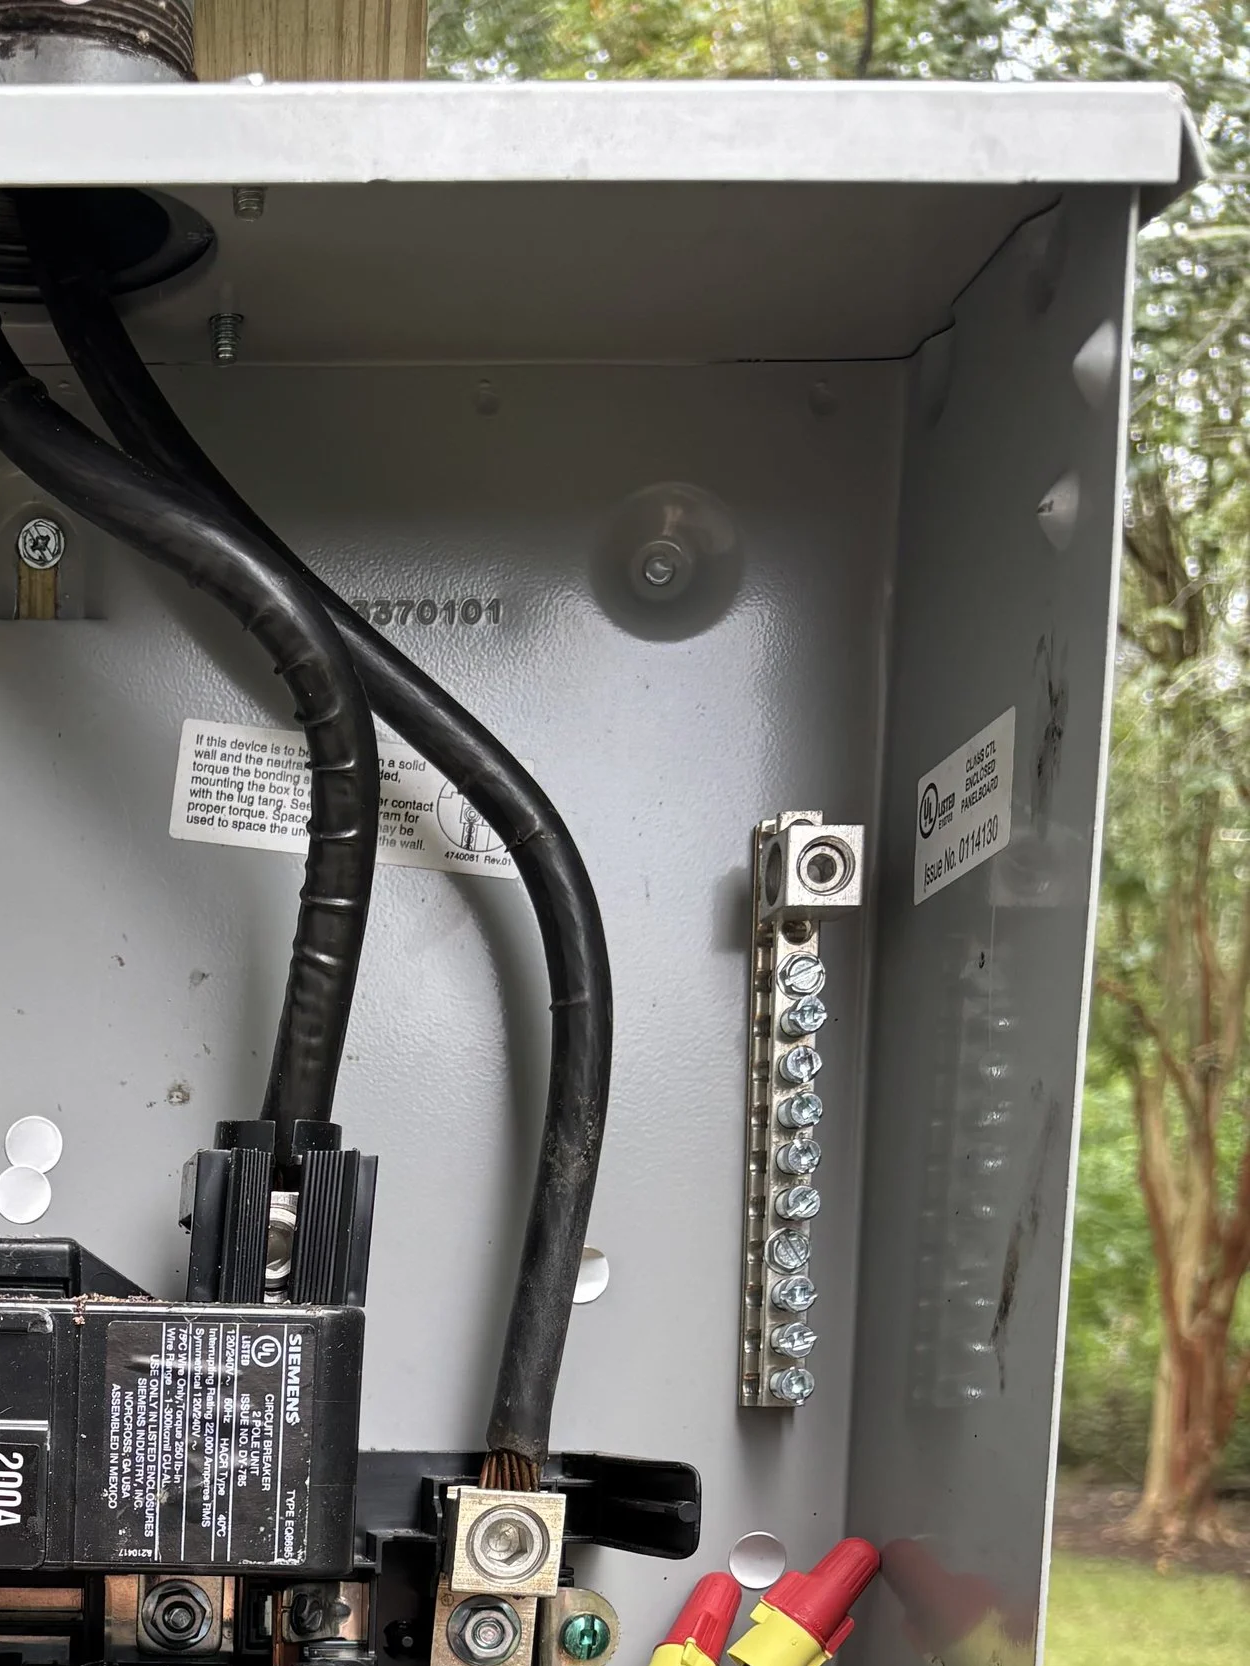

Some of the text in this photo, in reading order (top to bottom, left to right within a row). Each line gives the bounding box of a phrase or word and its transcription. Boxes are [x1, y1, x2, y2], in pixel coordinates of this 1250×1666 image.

[195, 749, 216, 759] wall
[220, 751, 241, 763] and
[245, 755, 262, 765] the
[196, 734, 203, 745] If
[207, 736, 226, 748] this
[230, 739, 267, 752] device
[271, 743, 280, 754] is
[284, 745, 294, 756] to
[389, 759, 395, 768] a
[399, 759, 426, 772] solid
[966, 740, 996, 773] CLASS CTL
[192, 761, 299, 785] torque the bonding
[966, 759, 995, 791] ENCLOSED
[190, 788, 212, 800] with
[216, 790, 233, 801] the
[238, 792, 254, 806] lug
[258, 795, 286, 811] tang.
[380, 811, 401, 821] ram
[404, 811, 419, 823] for
[191, 775, 244, 792] mounting
[248, 781, 265, 792] the
[269, 783, 289, 795] box
[294, 785, 304, 796] to
[392, 801, 434, 812] contact
[939, 792, 955, 818] LISTED
[961, 775, 998, 813] PANELBOARD
[187, 815, 213, 826] used
[218, 817, 228, 827] to
[232, 821, 266, 832] space
[270, 823, 287, 834] the
[379, 836, 396, 847] the
[401, 838, 425, 850] wall.
[188, 801, 224, 814] proper
[229, 804, 268, 819] torque.
[273, 810, 308, 823] Space
[400, 825, 413, 836] be
[924, 815, 998, 892] Issue No. 0114130
[167, 1328, 175, 1351] Wire
[241, 1335, 250, 1366] LISTED
[163, 1356, 174, 1385] Range
[178, 1352, 186, 1376] Wire
[192, 1328, 204, 1389] Symmetrical
[285, 1334, 302, 1425] SIEMENS
[223, 1398, 231, 1423] 60Hz
[240, 1394, 249, 1425] ISSUE
[201, 1328, 217, 1527] Interrupting Rating 22,000 Amperes RMS
[239, 1428, 248, 1448] NO.
[251, 1420, 260, 1448] POLE
[262, 1394, 274, 1491] CIRCUIT BREAKER
[108, 1384, 121, 1509] ASSEMBLED IN MEXICO
[121, 1392, 133, 1498] NORCROSS, GA USA
[133, 1378, 146, 1510] SIEMENS INDUSTRY, INC.
[144, 1354, 160, 1537] USE ONLY IN LISTED ENCLOSURES
[174, 1441, 184, 1459] 250
[218, 1438, 229, 1468] HACR
[173, 1461, 183, 1483] lb-in
[250, 1450, 259, 1476] UNIT
[217, 1471, 228, 1496] Type
[285, 1490, 295, 1517] TYPE
